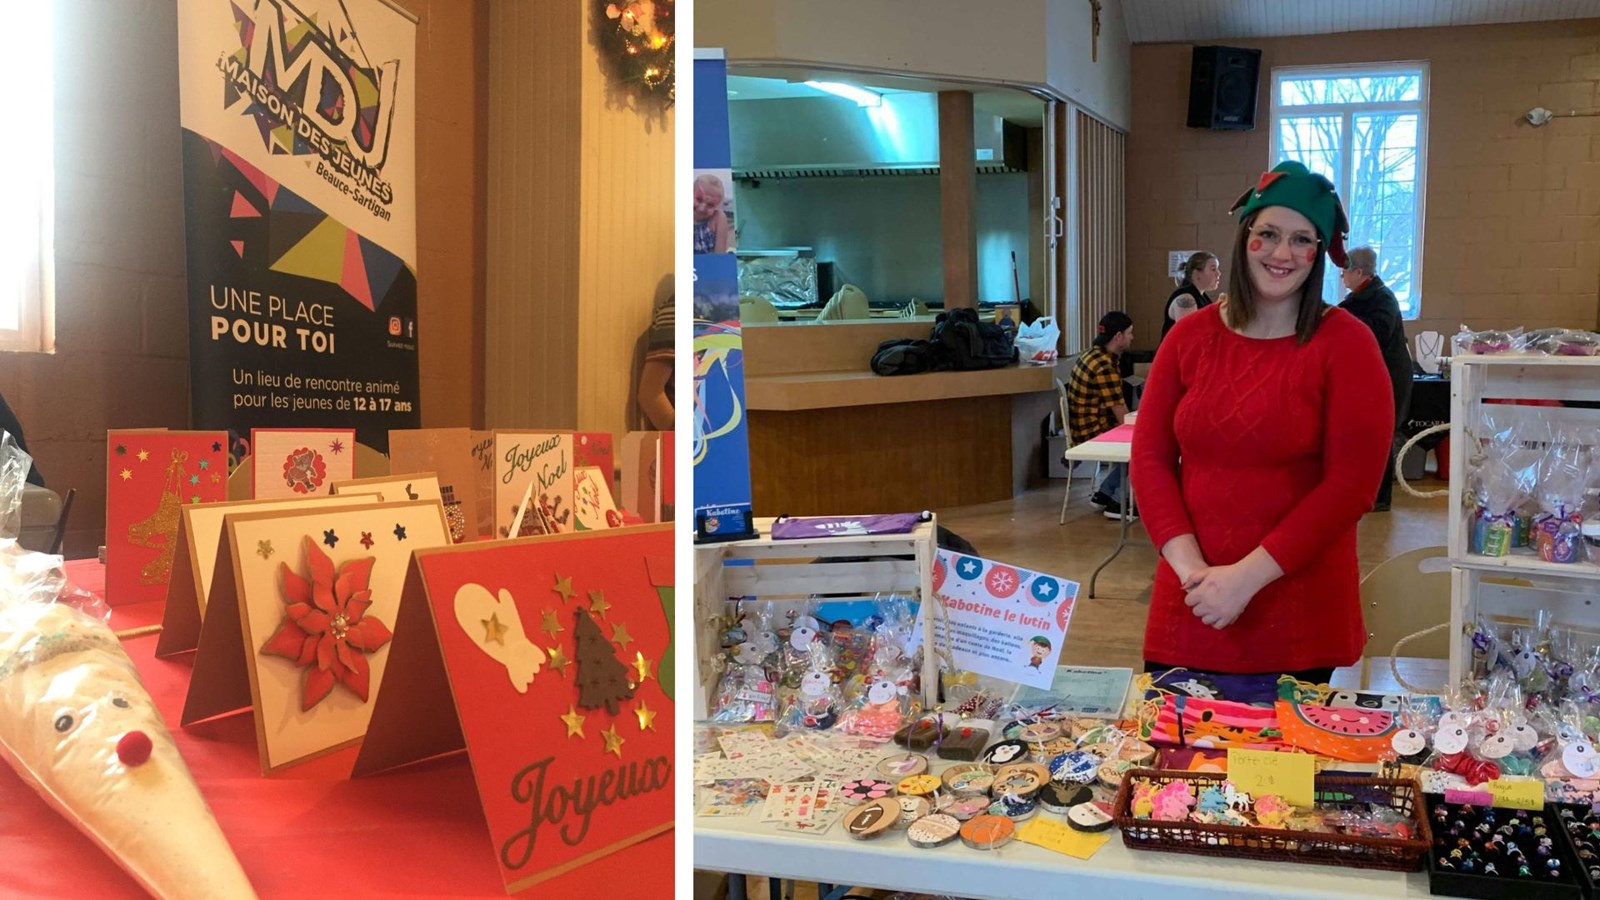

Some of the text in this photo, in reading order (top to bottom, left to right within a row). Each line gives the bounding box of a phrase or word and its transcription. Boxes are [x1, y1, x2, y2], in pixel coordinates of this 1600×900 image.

[247, 0, 399, 172] MDJ
[219, 54, 393, 202] MAISON DES JEUNES
[316, 161, 391, 222] Beauce-Sartigan
[210, 284, 335, 328] UNE PLACE
[211, 315, 335, 354] POUR TOI
[232, 368, 400, 395] Un lieu de rencontre animé
[234, 392, 412, 412] pour les jeunes de 12 à 17 ans
[502, 434, 561, 484] Joyeux
[534, 450, 568, 496] Noel
[941, 594, 1051, 632] Kabotine le lutin
[502, 756, 671, 870] Joyeux
